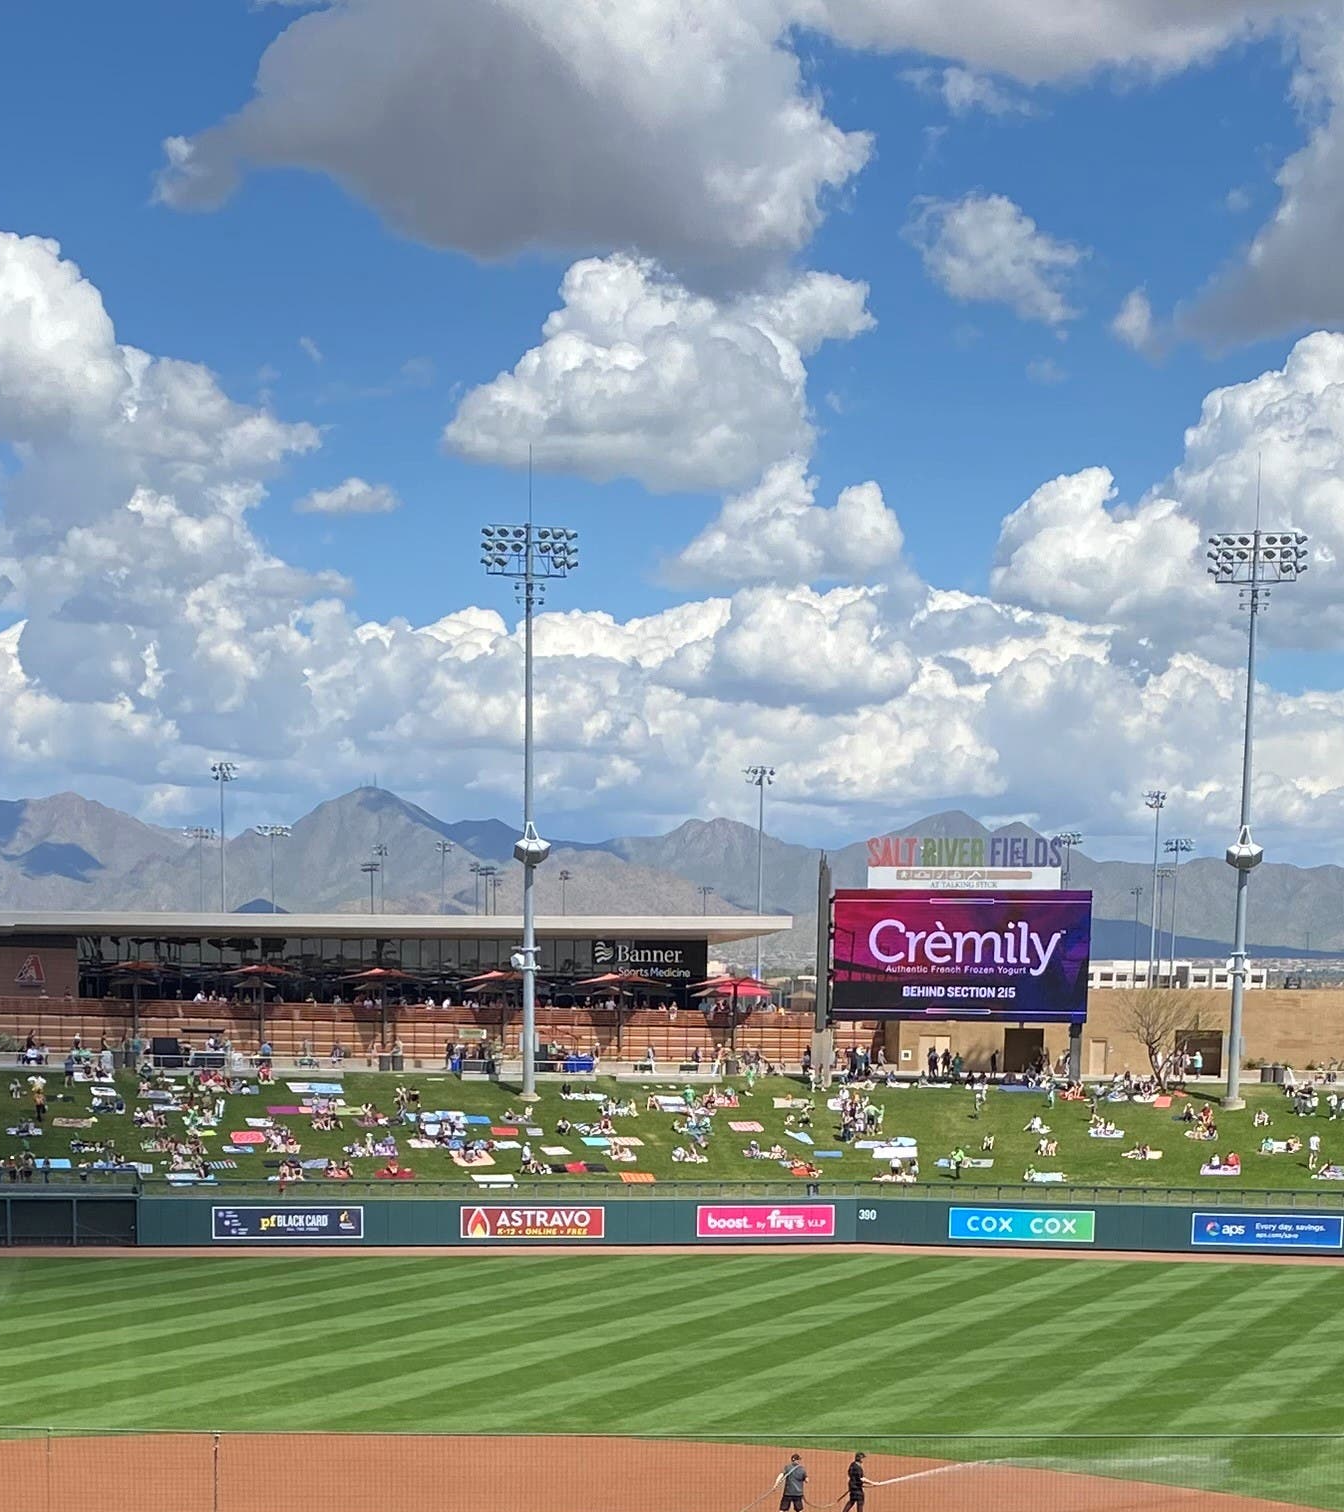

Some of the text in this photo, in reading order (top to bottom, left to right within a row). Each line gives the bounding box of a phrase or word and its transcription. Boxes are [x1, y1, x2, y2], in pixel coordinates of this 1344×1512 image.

[867, 837, 1062, 868] SALT RIVER FIELDS
[942, 881, 975, 889] TALKING
[975, 881, 998, 889] STICK
[616, 944, 683, 964] Banner
[868, 918, 1062, 977] Crèmily
[617, 966, 691, 978] Sports Medicine
[885, 964, 1027, 976] Authentic French Frozen Yogurt
[902, 986, 1017, 999] BEHIND SECTION 215
[276, 1214, 305, 1228] BLACK
[305, 1214, 329, 1228] CARD
[496, 1210, 591, 1227] ASTRAVO
[858, 1209, 877, 1221] 390
[966, 1215, 1077, 1234] COX COX
[1221, 1224, 1246, 1237] aps
[1255, 1222, 1276, 1231] Every
[525, 1227, 557, 1236] ONLINE
[566, 1227, 589, 1236] FREE
